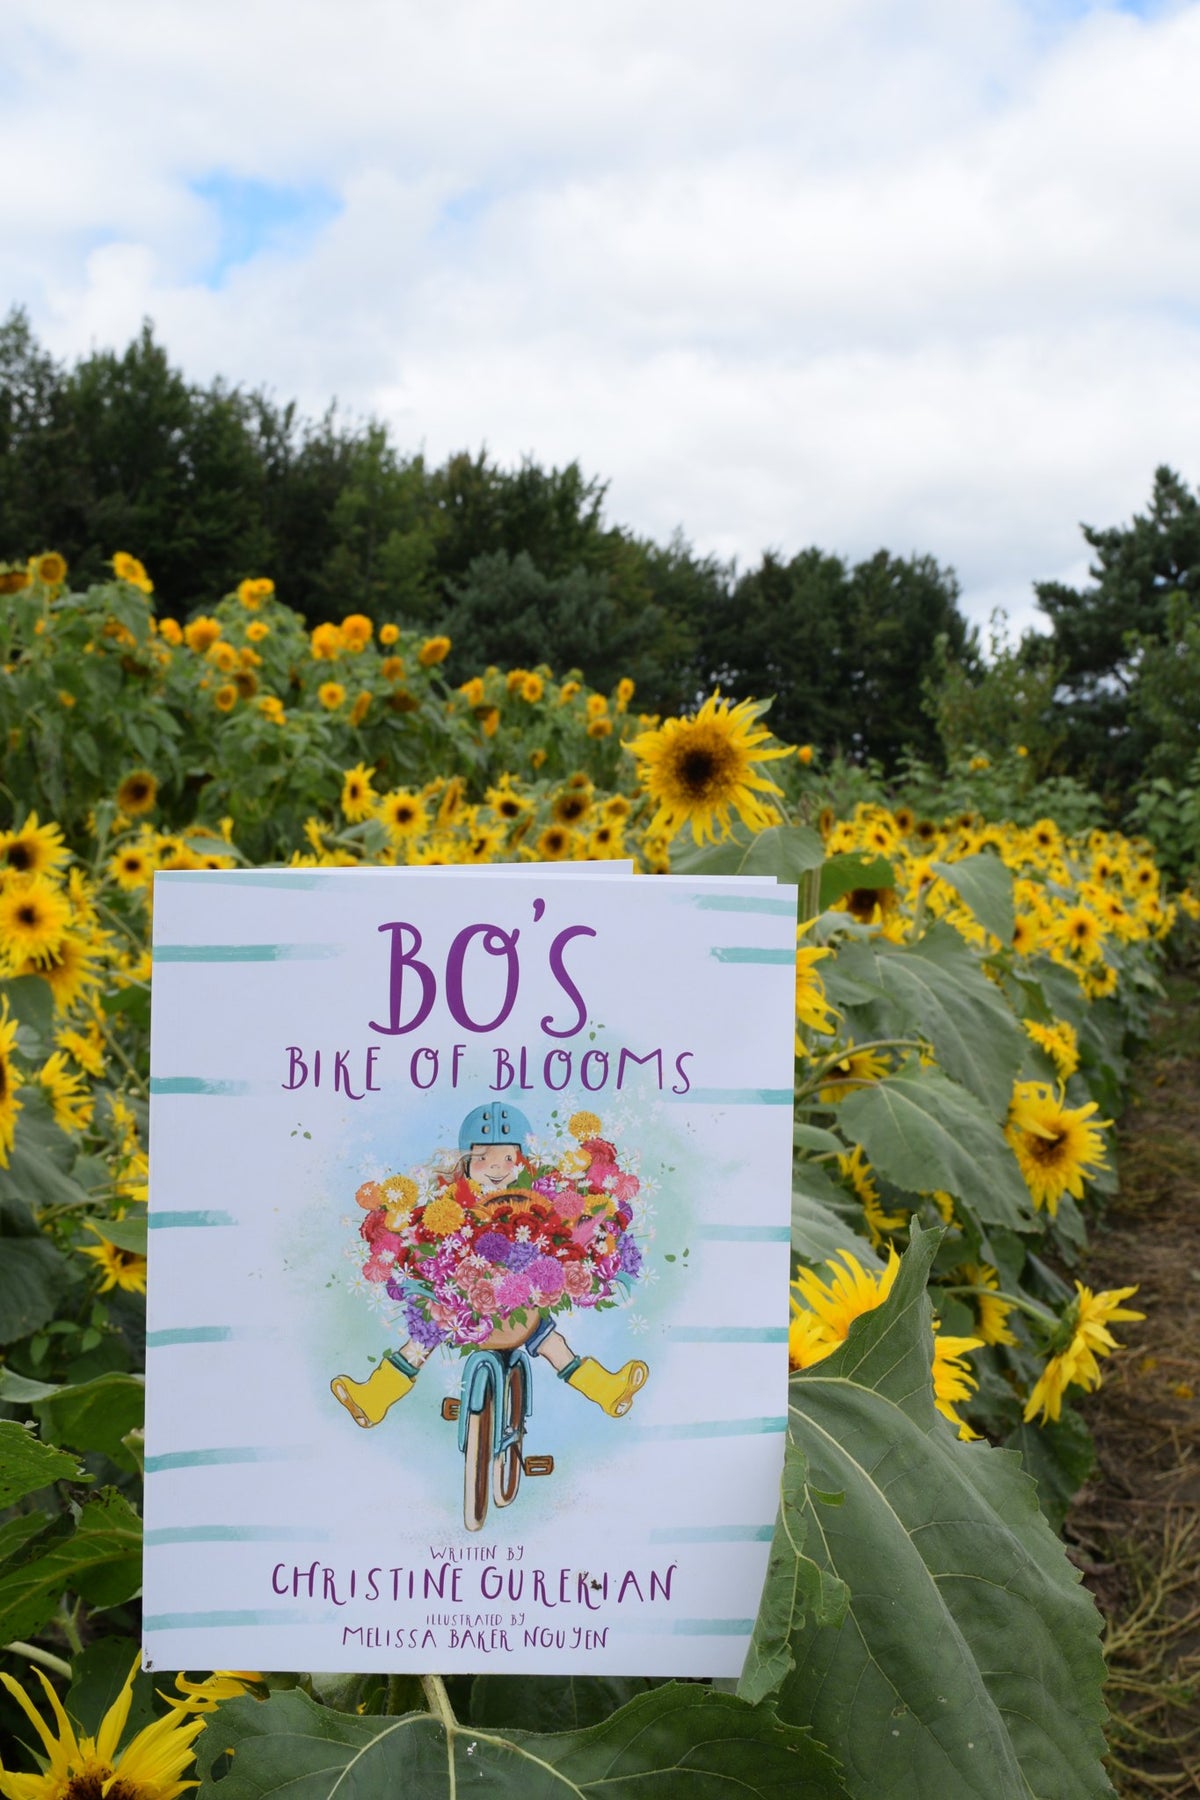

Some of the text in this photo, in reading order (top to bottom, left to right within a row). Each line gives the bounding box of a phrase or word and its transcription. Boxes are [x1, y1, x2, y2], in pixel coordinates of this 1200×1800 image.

[368, 898, 597, 1038] BO'S
[281, 1044, 694, 1101] BIKE OF BLOOMS
[430, 1545, 524, 1562] WRITTEN BY
[271, 1562, 677, 1610] CHRISTINE GUREKIAN
[426, 1612, 525, 1628] ILLUSTRATED BY
[342, 1627, 609, 1653] MELISSA BAKER NGUYEN
